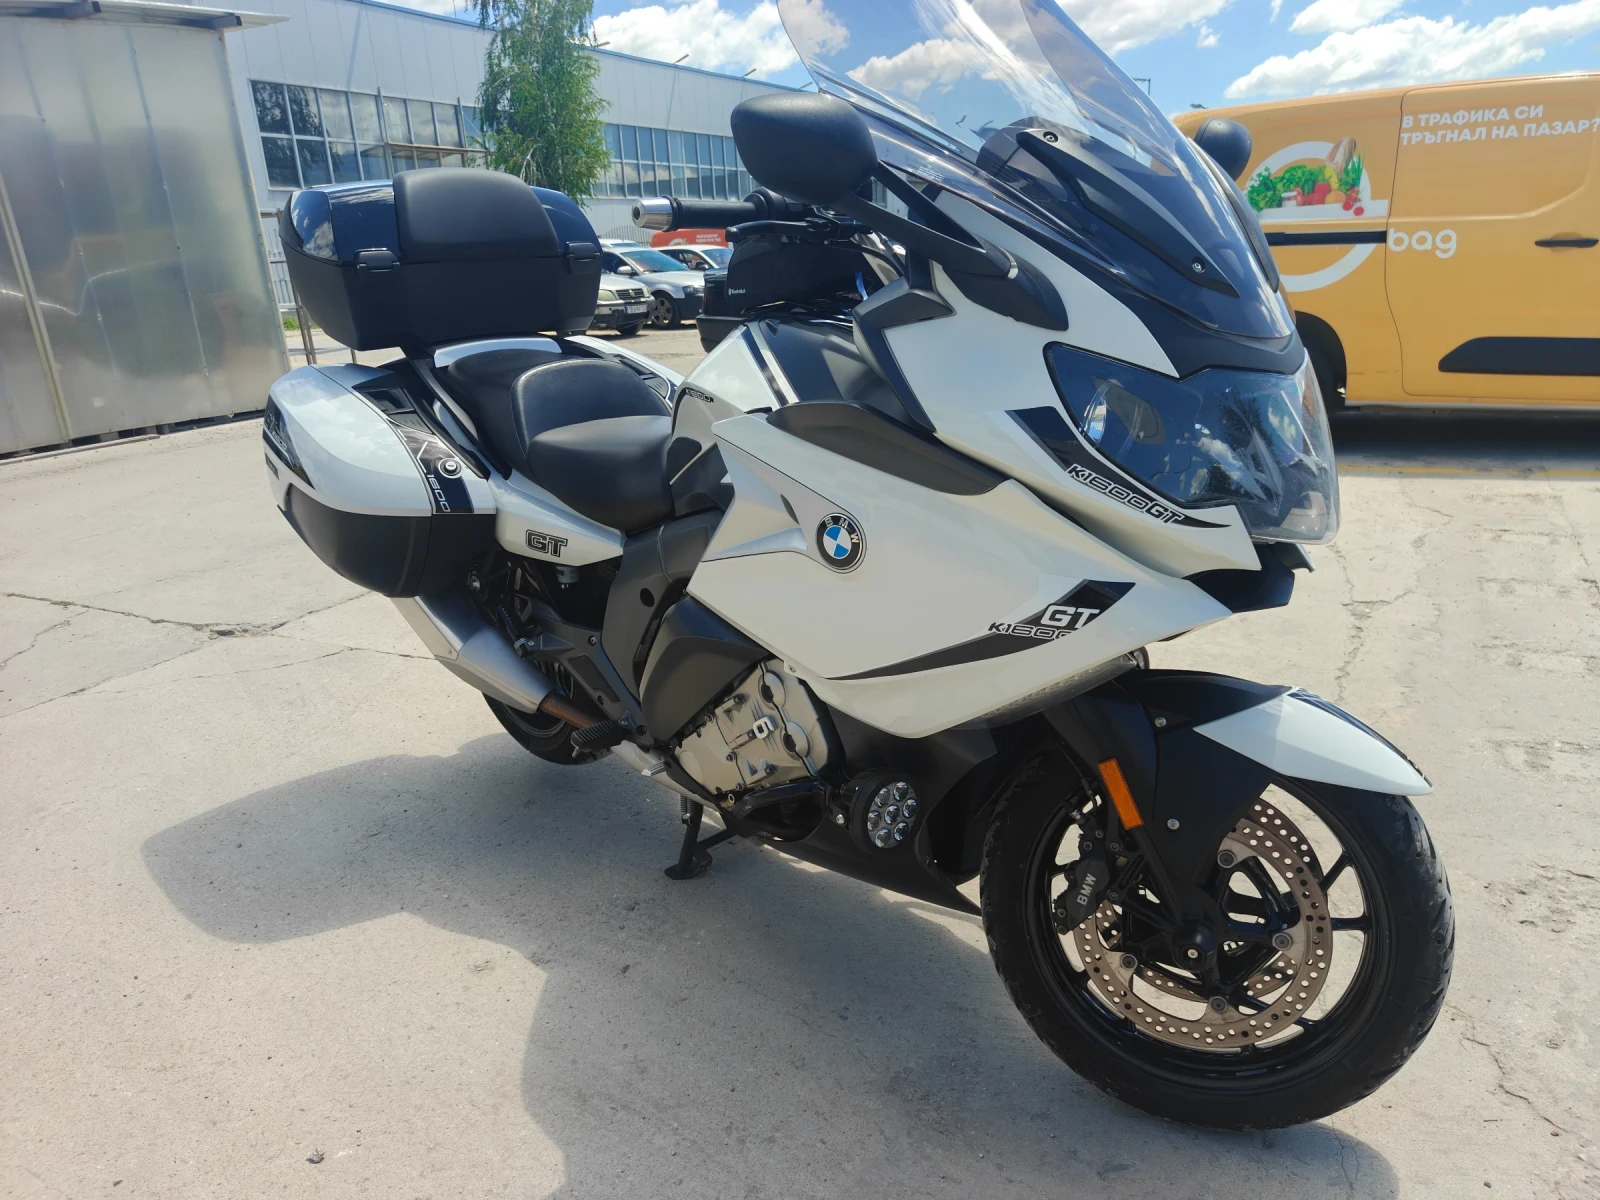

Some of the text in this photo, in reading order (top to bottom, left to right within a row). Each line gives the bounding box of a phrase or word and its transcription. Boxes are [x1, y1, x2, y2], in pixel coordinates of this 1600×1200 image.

[1402, 104, 1545, 129] В ТРАФИКА СИ
[1400, 126, 1487, 146] ТРЪГНАЛ
[1491, 125, 1519, 139] НА
[824, 516, 860, 543] BMW
[525, 529, 568, 558] GT
[1040, 604, 1100, 629] GT
[1076, 872, 1097, 906] BMW
